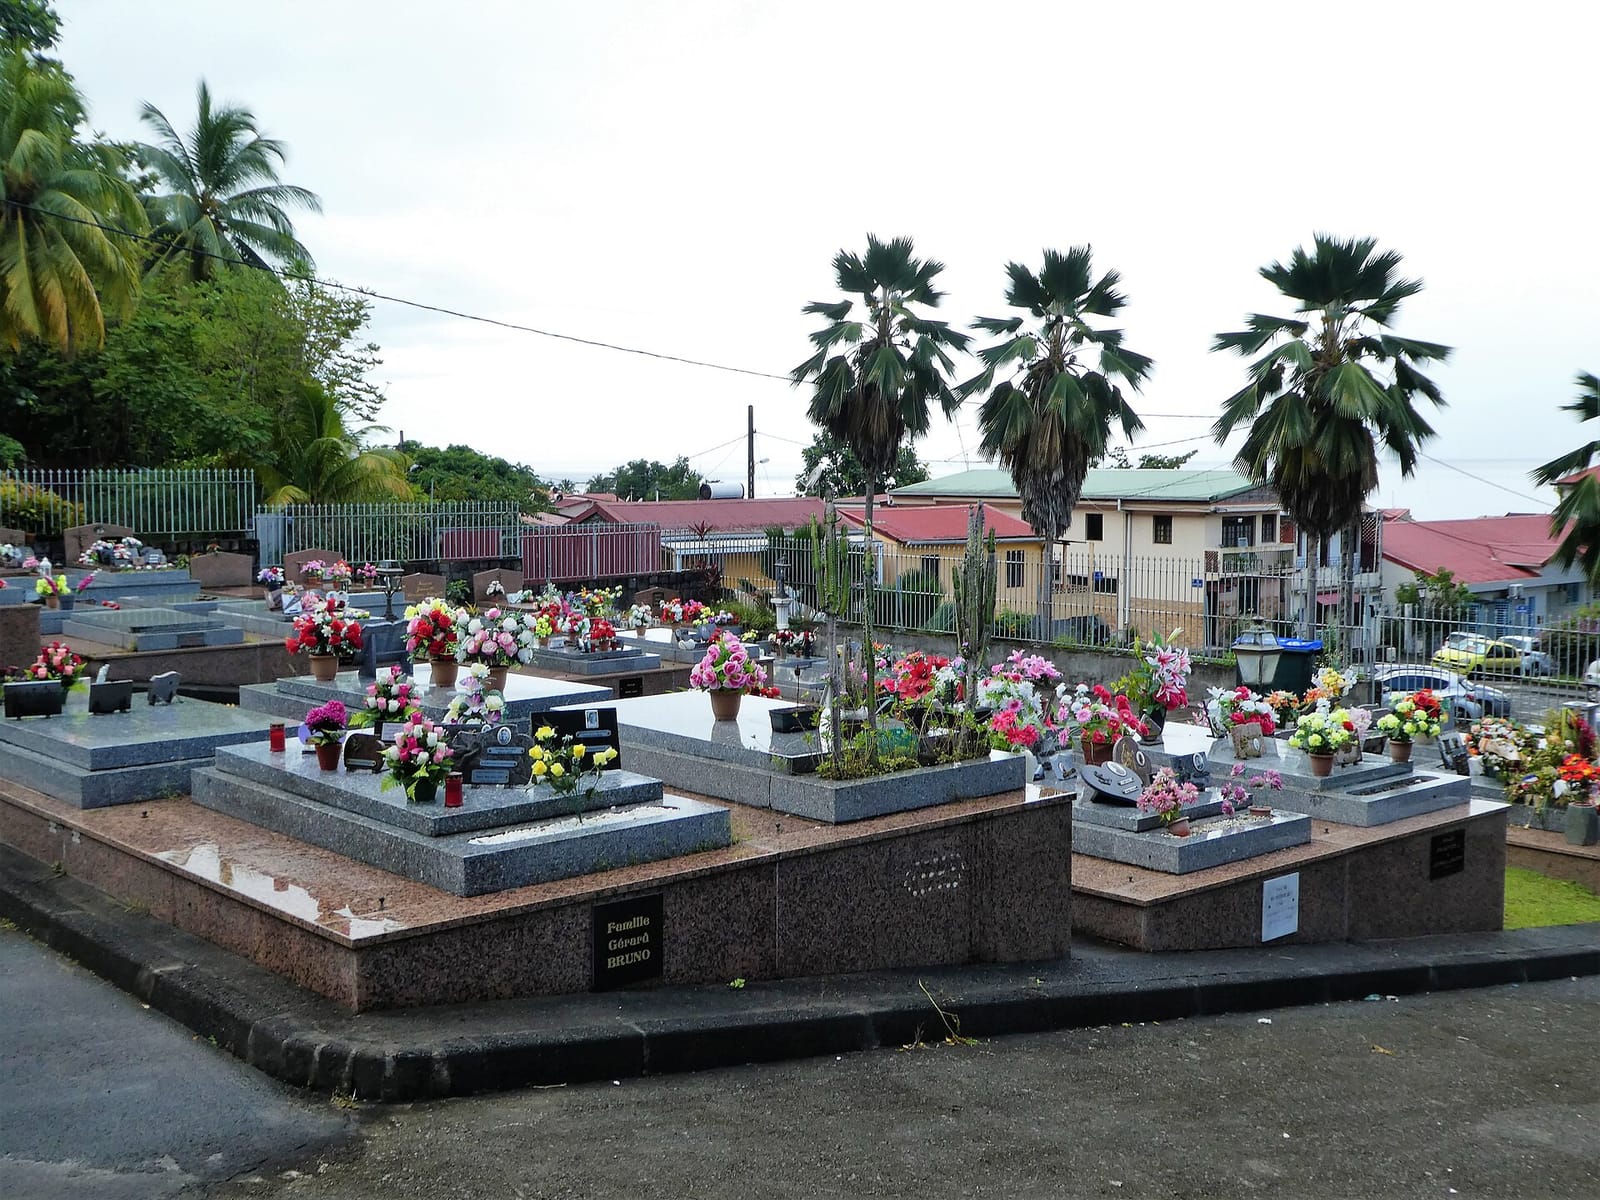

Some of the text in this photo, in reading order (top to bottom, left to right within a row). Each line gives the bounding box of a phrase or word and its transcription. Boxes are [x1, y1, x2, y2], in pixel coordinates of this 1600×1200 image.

[607, 916, 650, 934] Famille
[608, 932, 650, 951] Gérard
[607, 949, 651, 969] BRUNO
